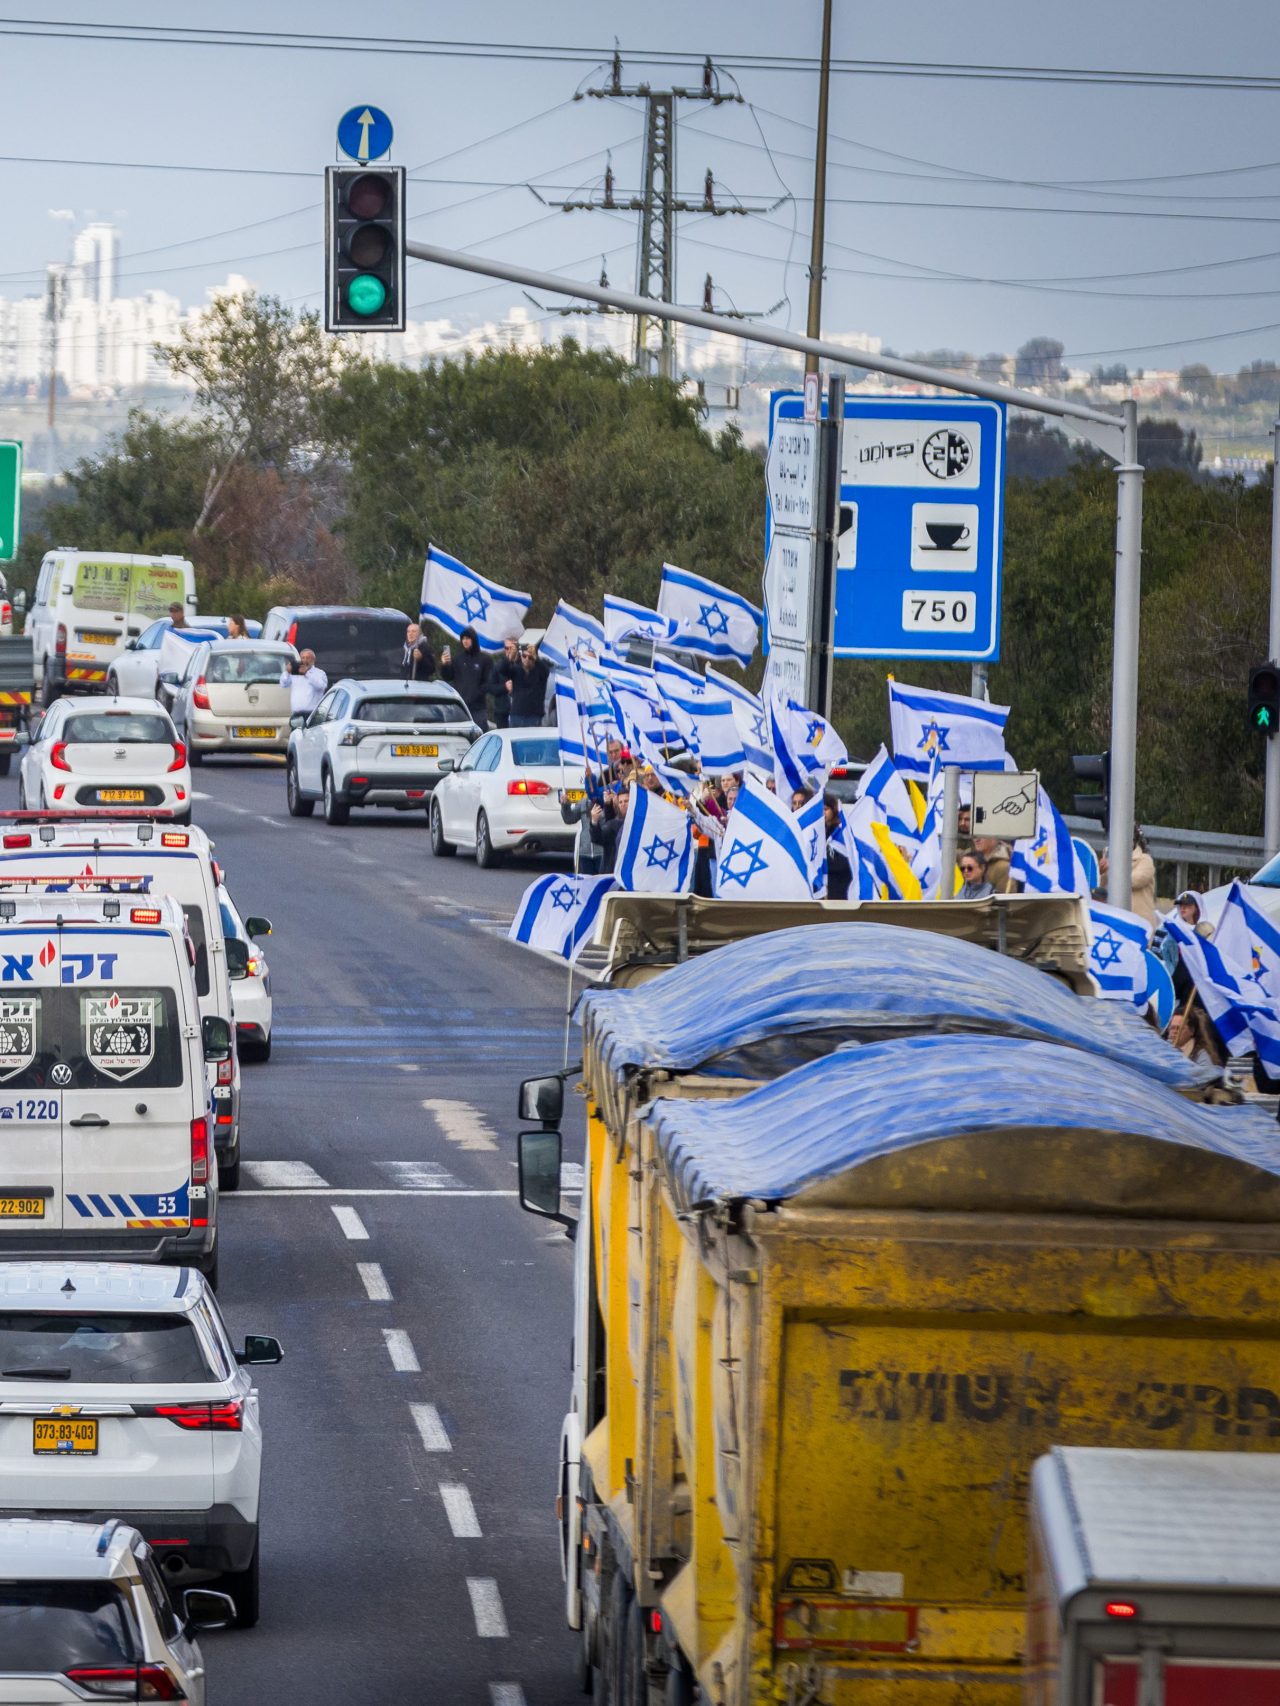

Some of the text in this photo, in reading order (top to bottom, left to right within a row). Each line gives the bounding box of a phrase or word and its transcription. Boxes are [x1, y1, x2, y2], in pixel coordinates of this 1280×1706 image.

[910, 599, 968, 623] 750
[16, 1099, 59, 1120] 1220
[157, 1196, 177, 1214] 53
